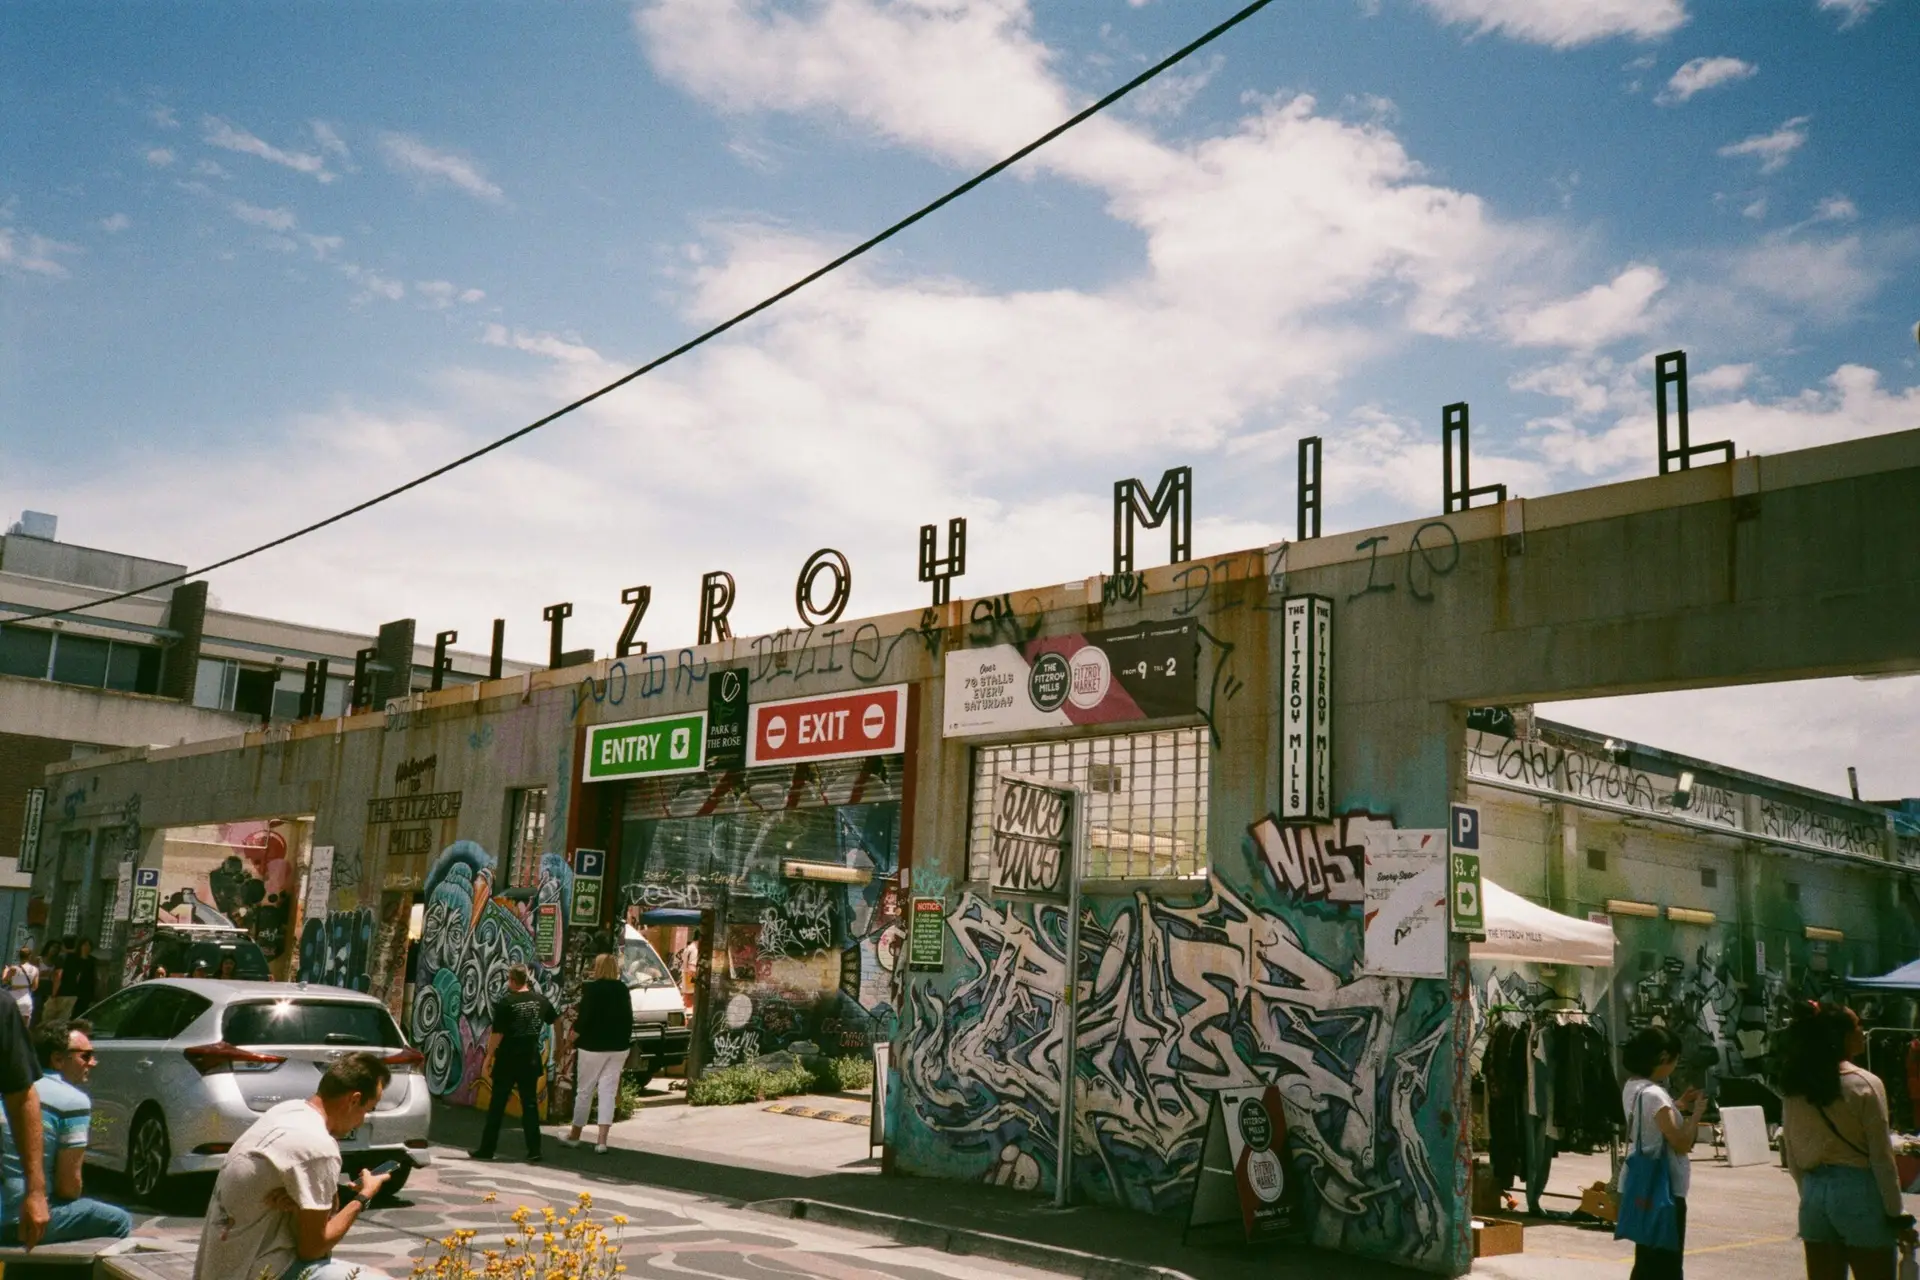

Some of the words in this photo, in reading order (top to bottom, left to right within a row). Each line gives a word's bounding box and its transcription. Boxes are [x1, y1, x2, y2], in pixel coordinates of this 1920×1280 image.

[432, 517, 966, 691] FITZROY
[1288, 606, 1304, 615] THE
[1317, 606, 1329, 617] THE
[1044, 662, 1057, 672] THE
[1138, 661, 1148, 679] 9
[1166, 658, 1176, 676] 2
[1290, 621, 1302, 723] FITZROY
[1318, 622, 1326, 726] FITZROY
[964, 678, 978, 689] 70
[980, 673, 1014, 687] STALLS
[1034, 672, 1065, 684] FITZROY
[1074, 678, 1101, 692] MARKET
[974, 686, 1004, 700] EVERY
[1040, 682, 1060, 692] MILLS
[964, 696, 1014, 712] SATURDAY
[710, 724, 730, 735] PARK
[798, 710, 850, 744] EXIT
[601, 733, 661, 765] ENTRY
[707, 740, 722, 748] THE
[722, 736, 741, 747] ROSE
[1290, 734, 1301, 809] MILLS
[1316, 735, 1326, 810] MILLS
[366, 799, 393, 823] THE
[396, 791, 462, 821] FITZROY
[1458, 812, 1472, 843] P
[582, 854, 596, 872] P
[142, 872, 154, 885] P
[1376, 871, 1397, 884] Every
[917, 902, 940, 910] NOTICE
[1248, 1108, 1259, 1116] THE
[1243, 1118, 1266, 1126] FITZROY
[1248, 1126, 1265, 1134] MILLS
